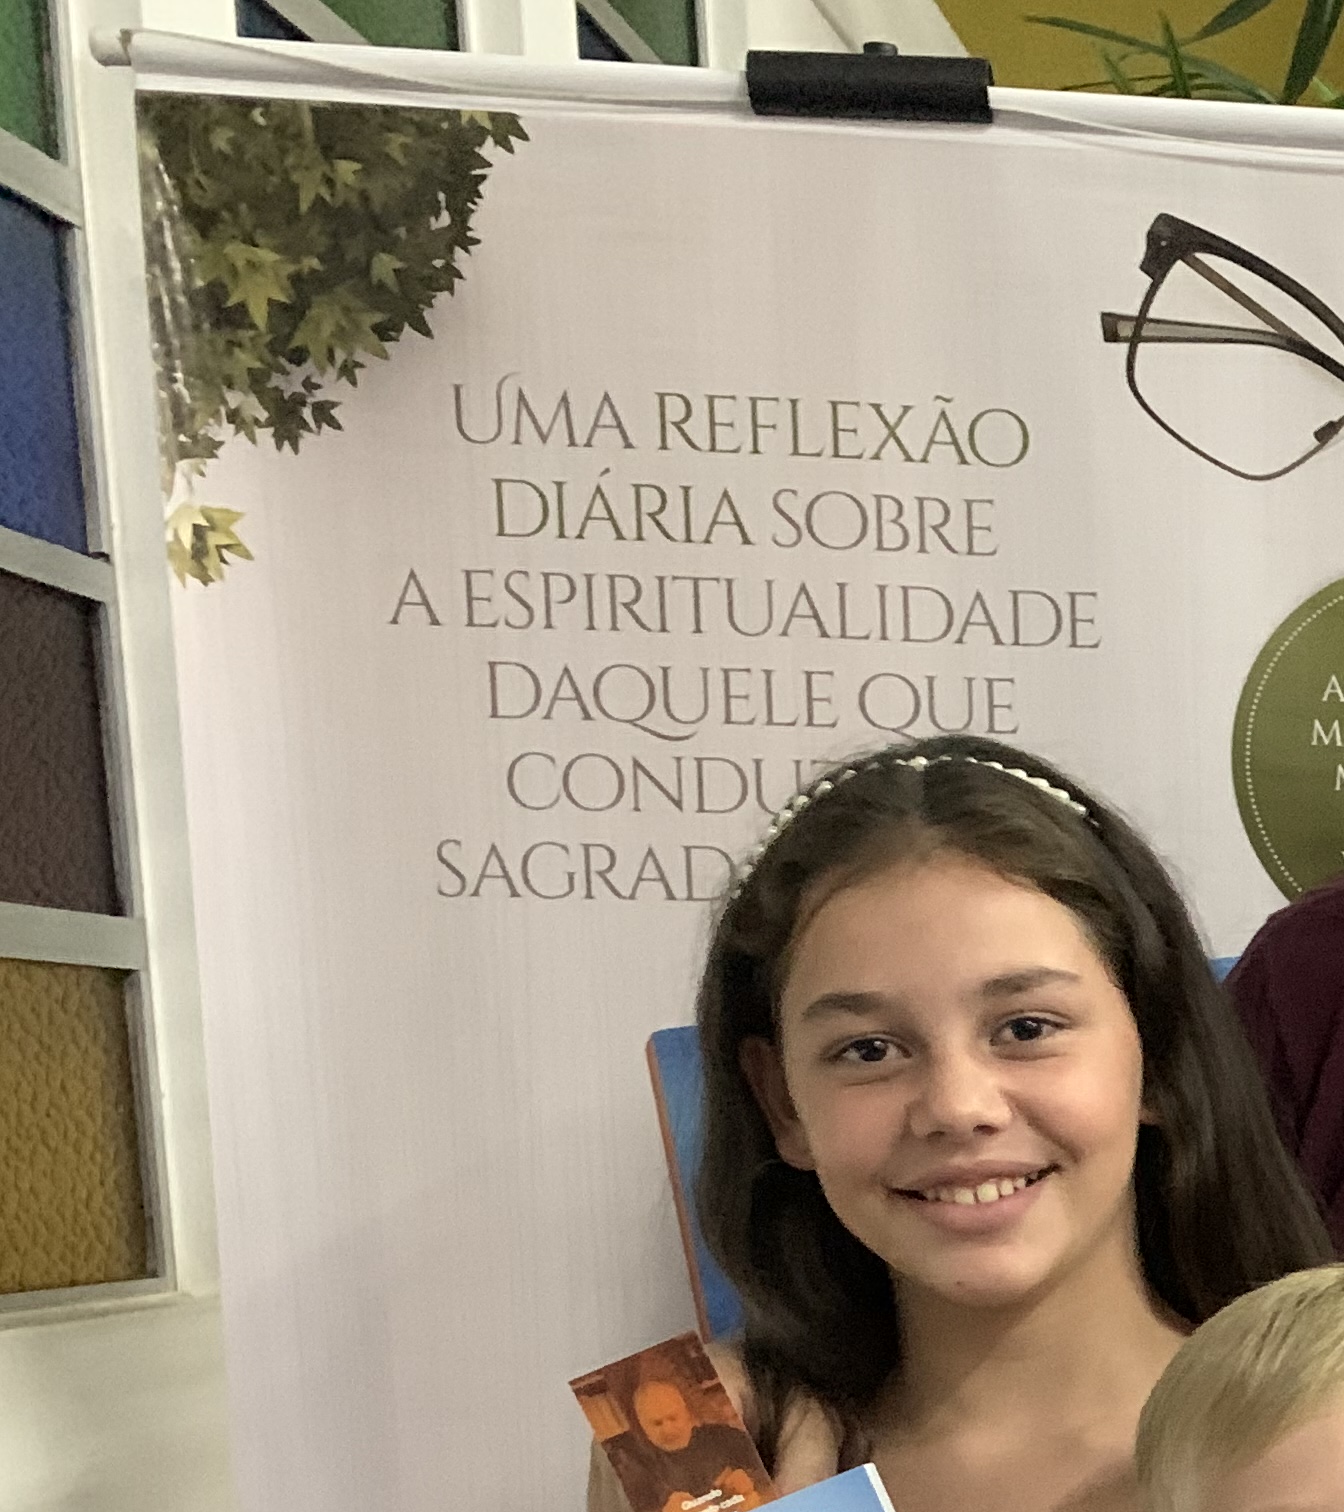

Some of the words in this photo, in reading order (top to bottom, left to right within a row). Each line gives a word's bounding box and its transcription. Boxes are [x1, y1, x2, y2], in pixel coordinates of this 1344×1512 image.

[452, 371, 639, 450] UMA
[654, 391, 1031, 468] REFLEXÃO
[490, 467, 757, 547] DIÁRIA
[770, 488, 1000, 558] SOBRE
[388, 568, 443, 628] A
[462, 569, 1102, 650] ESPIRITUALIDADE
[486, 659, 841, 742] DAQUELE
[857, 671, 1021, 745] QUE
[505, 751, 850, 815] CONDU
